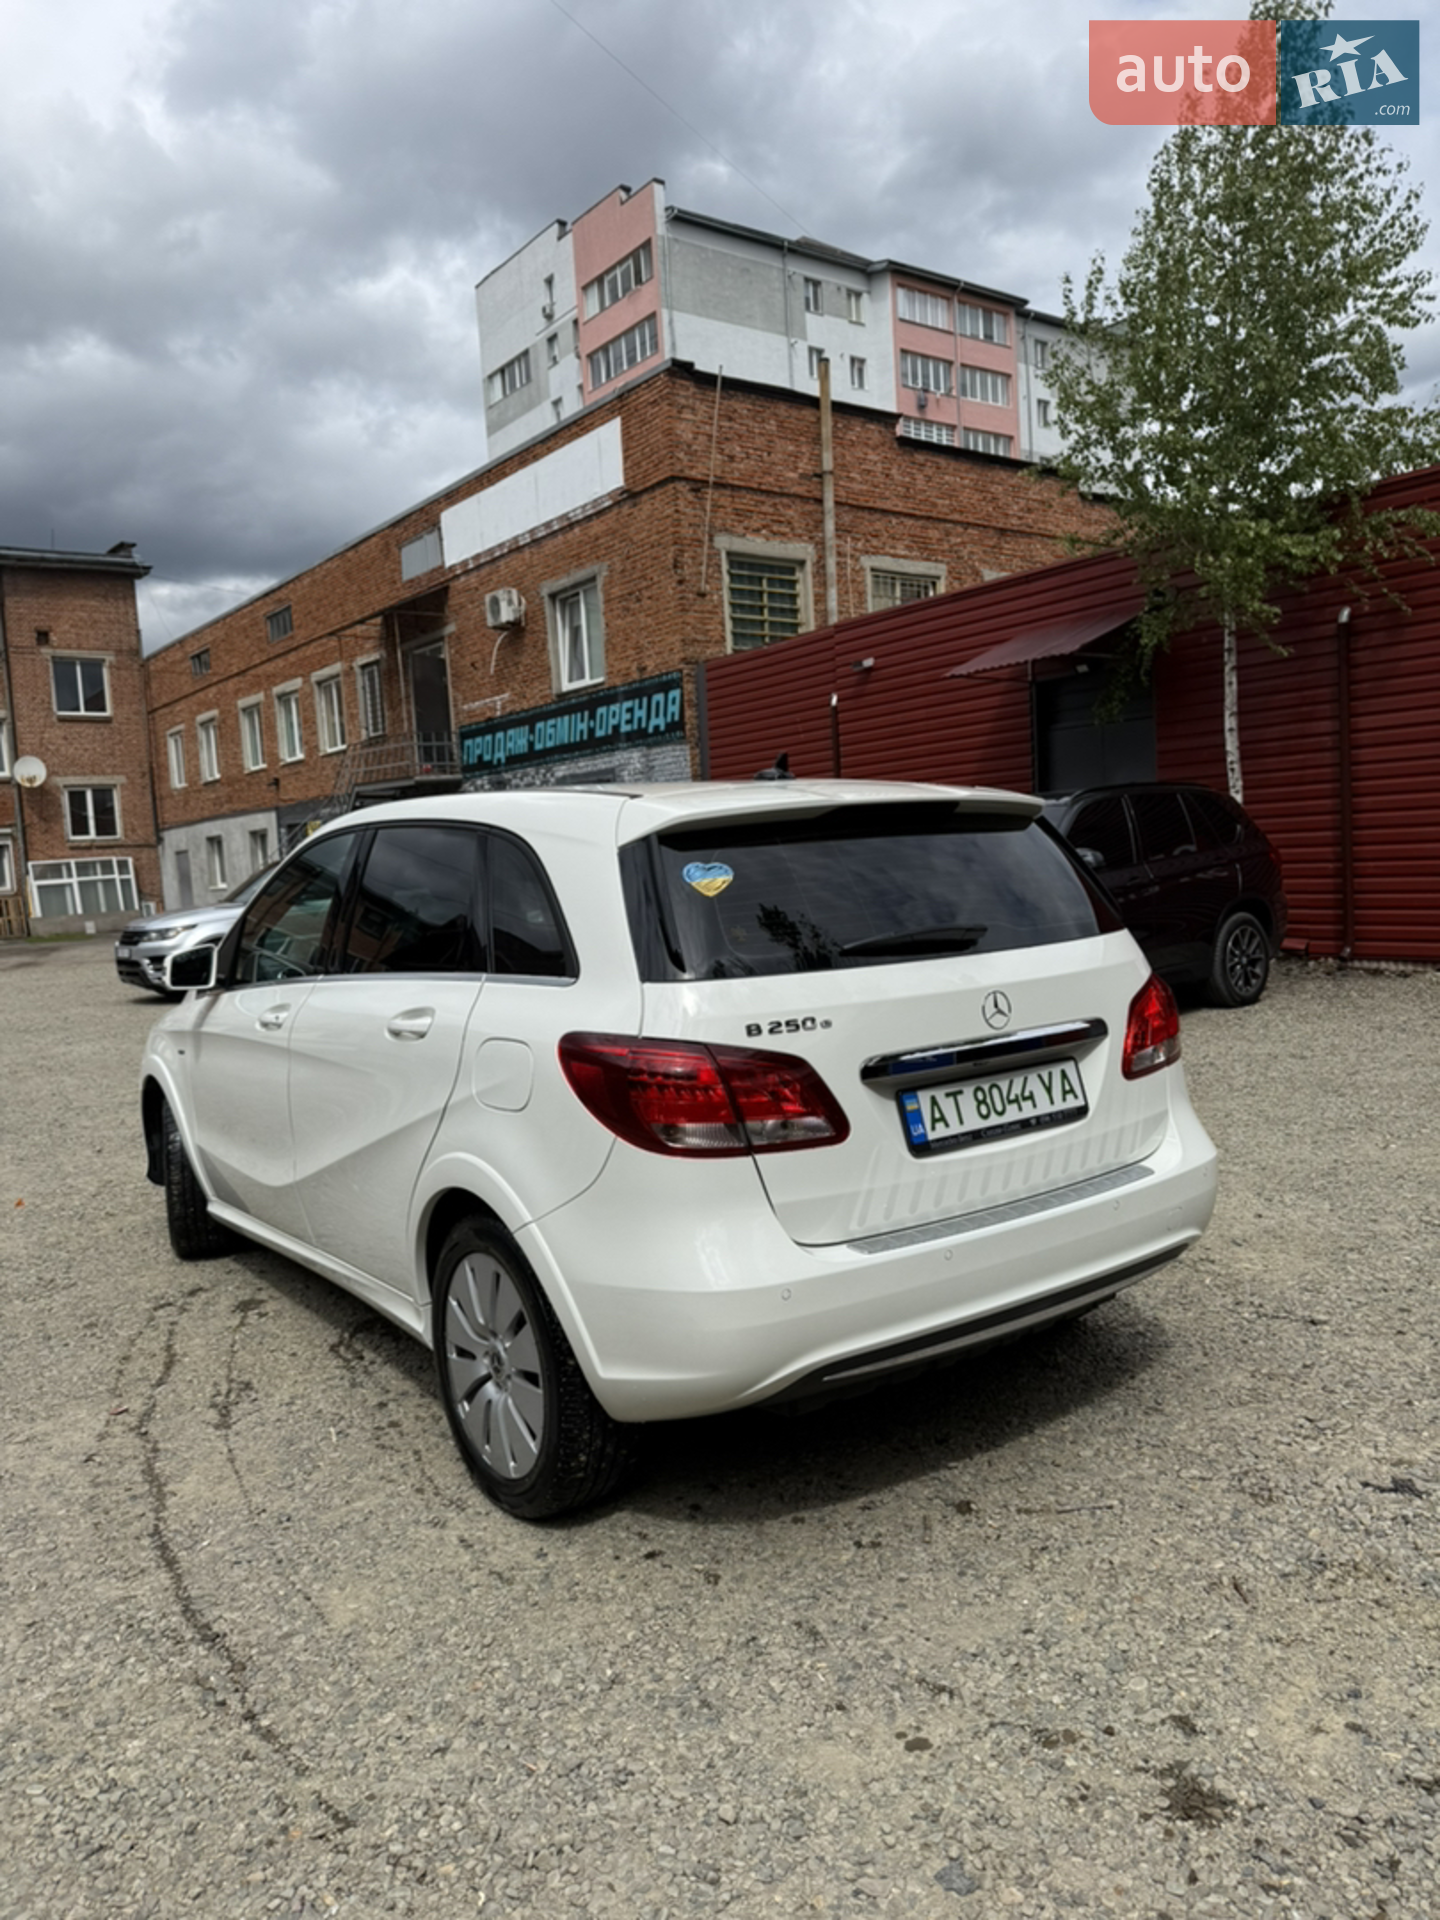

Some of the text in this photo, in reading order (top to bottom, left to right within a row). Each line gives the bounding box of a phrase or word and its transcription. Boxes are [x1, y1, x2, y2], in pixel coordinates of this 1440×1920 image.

[745, 1022, 763, 1038] B
[930, 1089, 964, 1131] AT
[973, 1075, 1037, 1120] 8044
[1037, 1068, 1079, 1106] YA
[910, 1123, 925, 1137] UA
